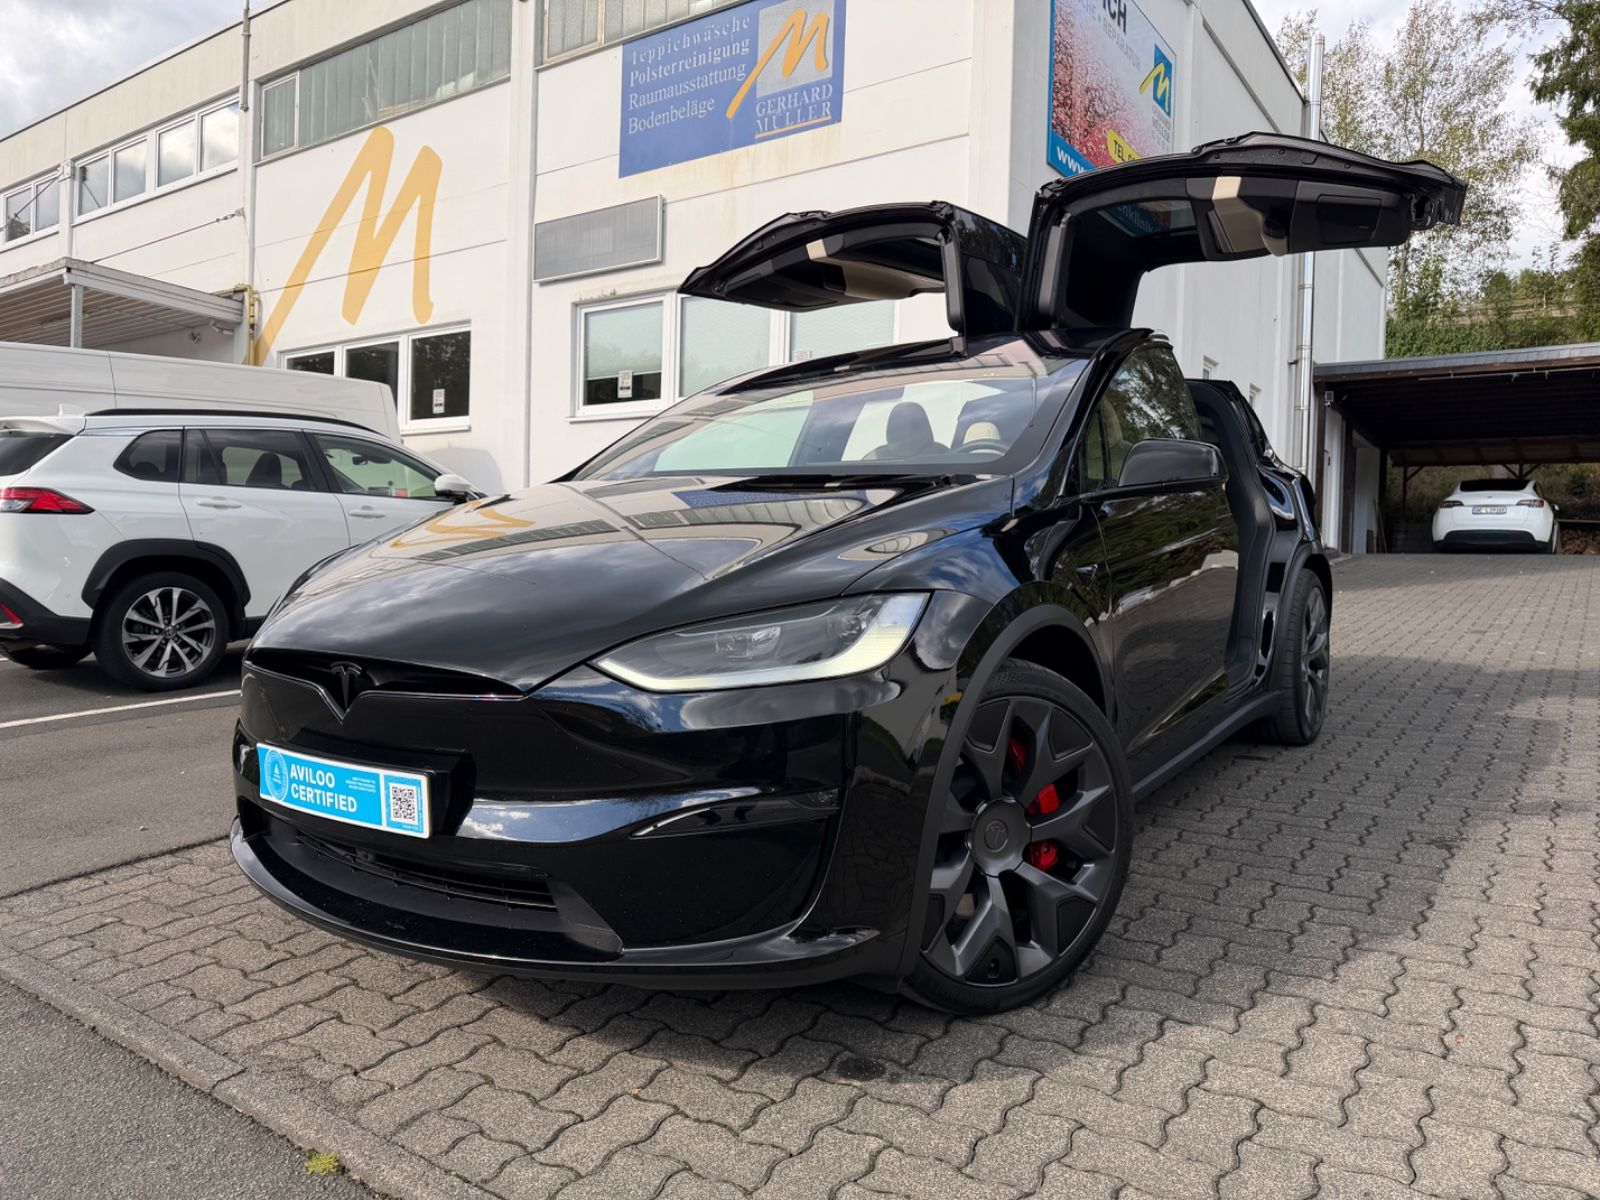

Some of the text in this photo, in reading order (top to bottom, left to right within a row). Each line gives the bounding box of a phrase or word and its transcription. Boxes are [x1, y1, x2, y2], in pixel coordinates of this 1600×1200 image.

[632, 15, 750, 65] Teppichwäsche
[630, 38, 750, 87] Polsterreinigung
[629, 63, 746, 110] Raumausstattung
[756, 83, 832, 117] GERHARD
[628, 97, 715, 134] Bodenbeläge
[290, 764, 335, 788] AVILOO
[291, 783, 357, 812] CERTIFIED
